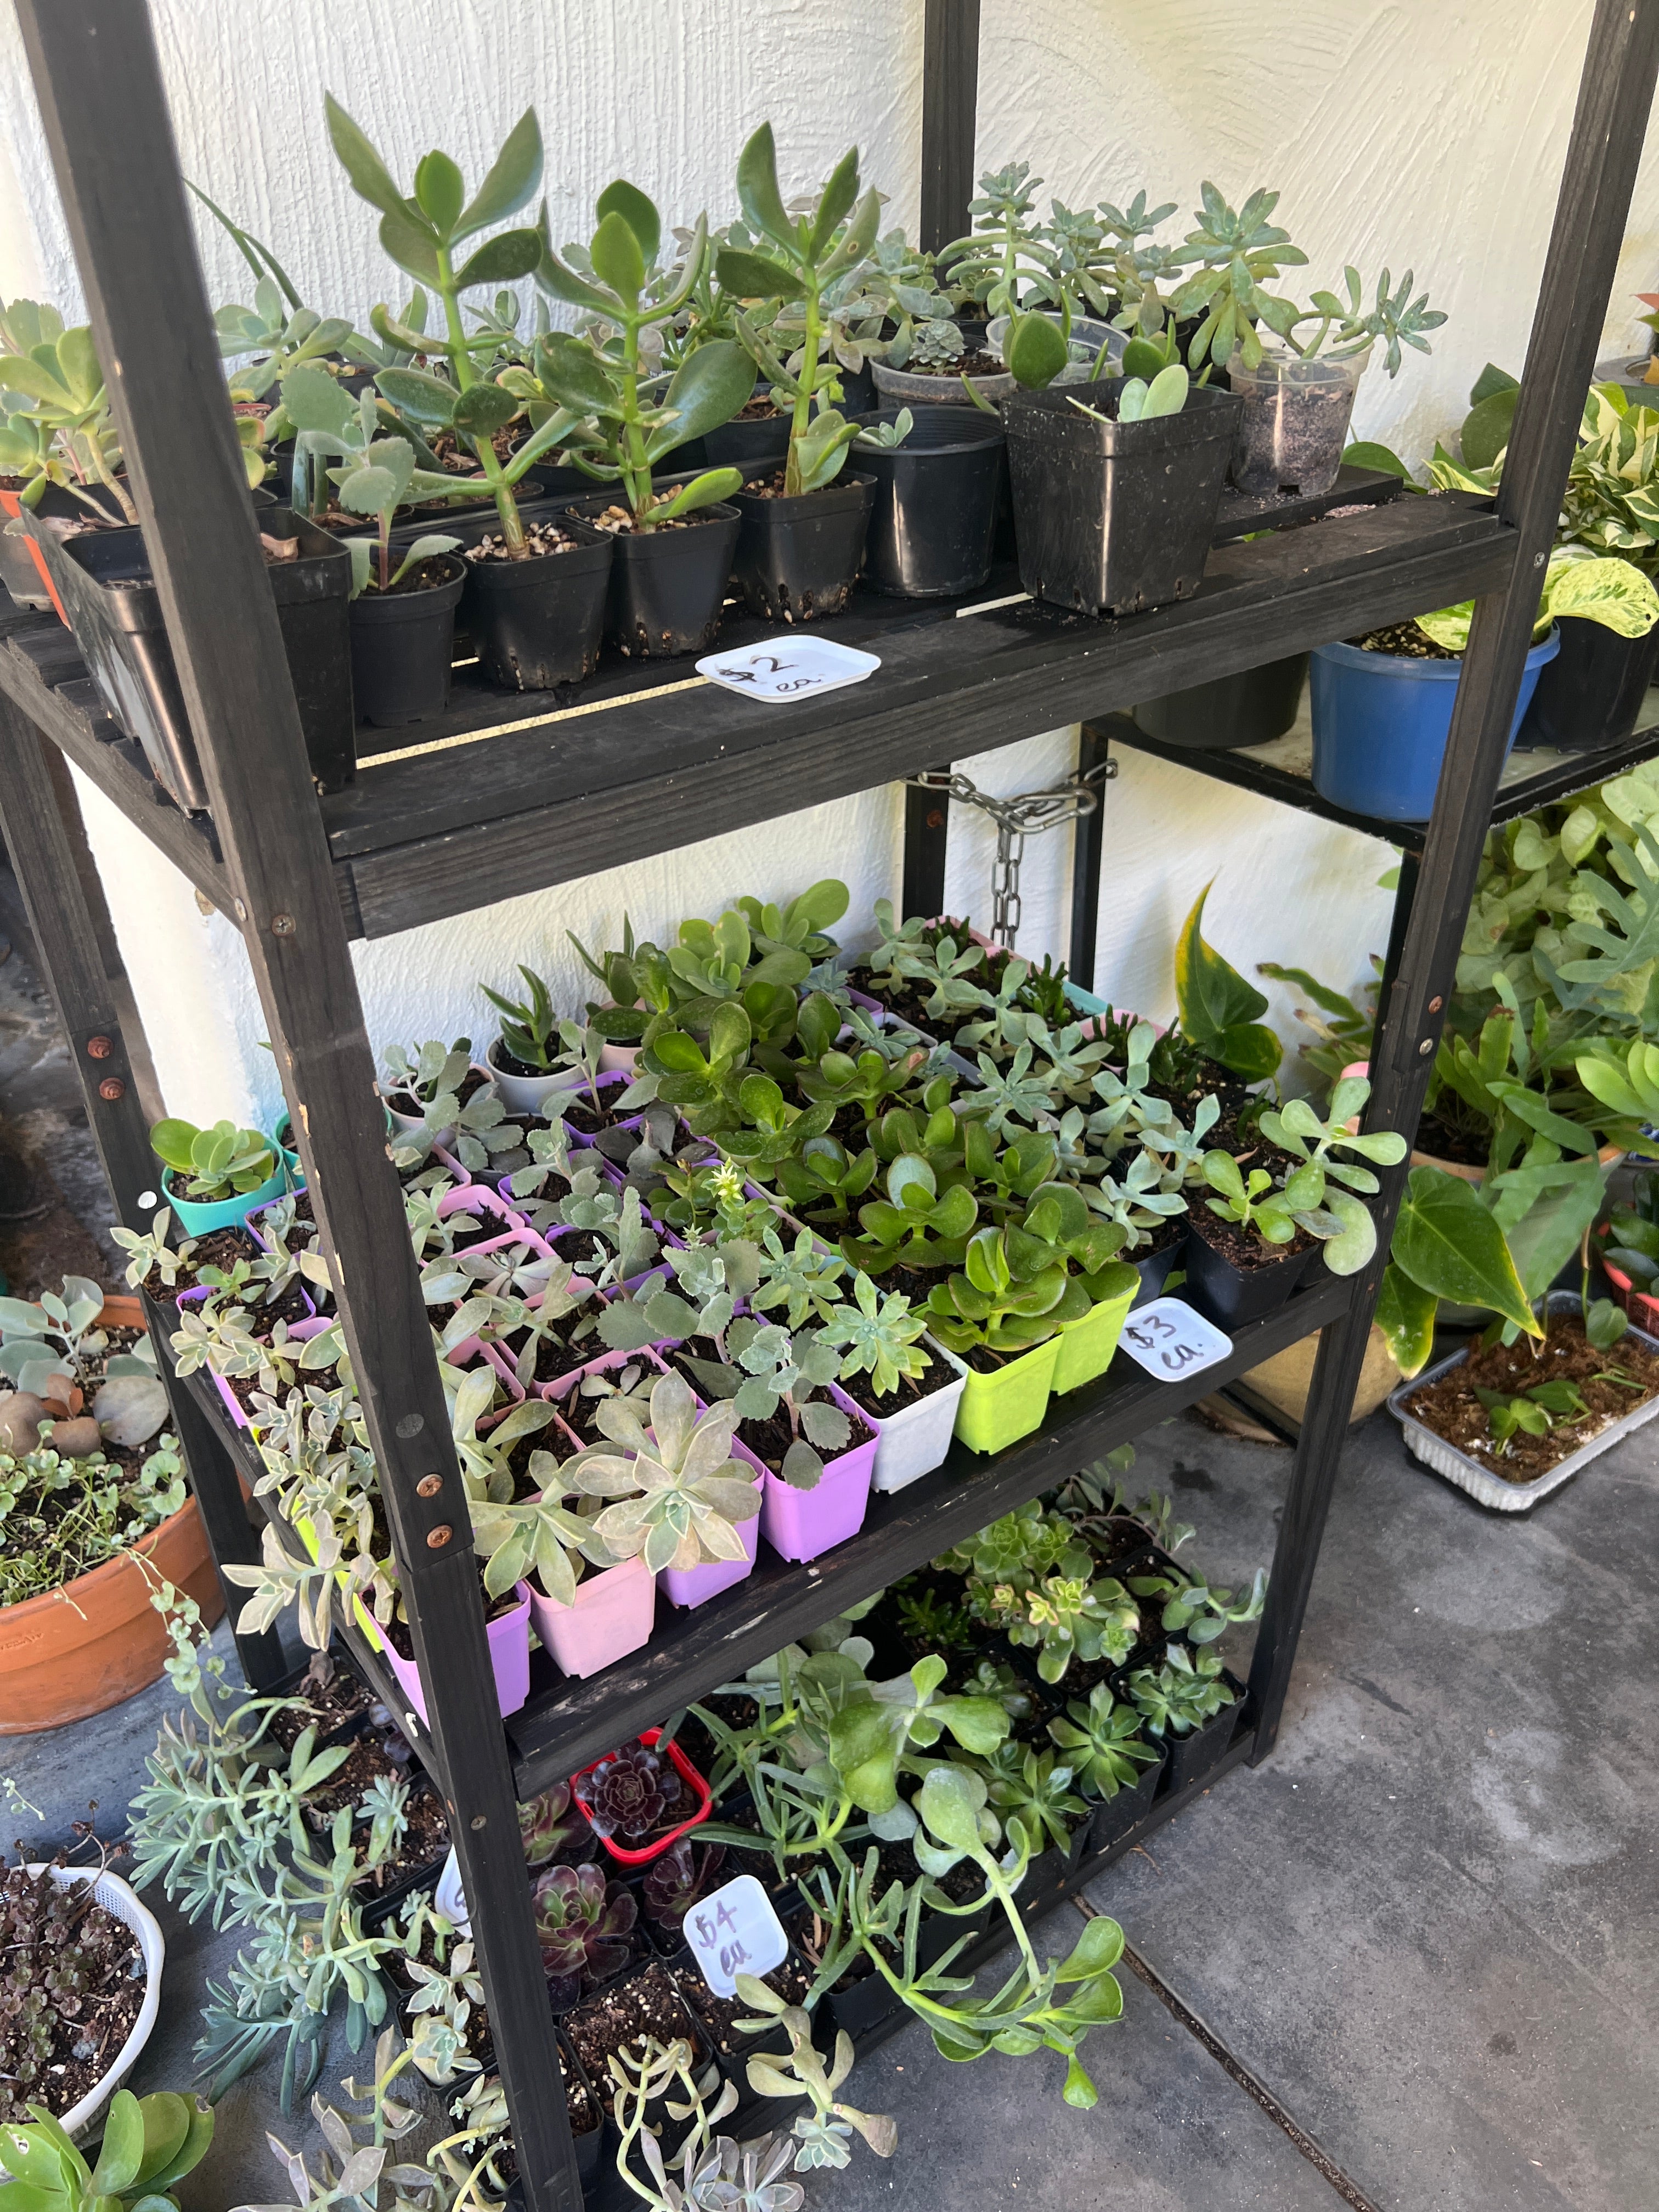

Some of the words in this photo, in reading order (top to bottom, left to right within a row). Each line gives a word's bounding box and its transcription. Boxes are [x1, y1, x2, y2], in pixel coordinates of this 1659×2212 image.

[716, 656, 798, 682] $2
[1125, 1315, 1177, 1349] $3
[695, 1900, 737, 1949] $4
